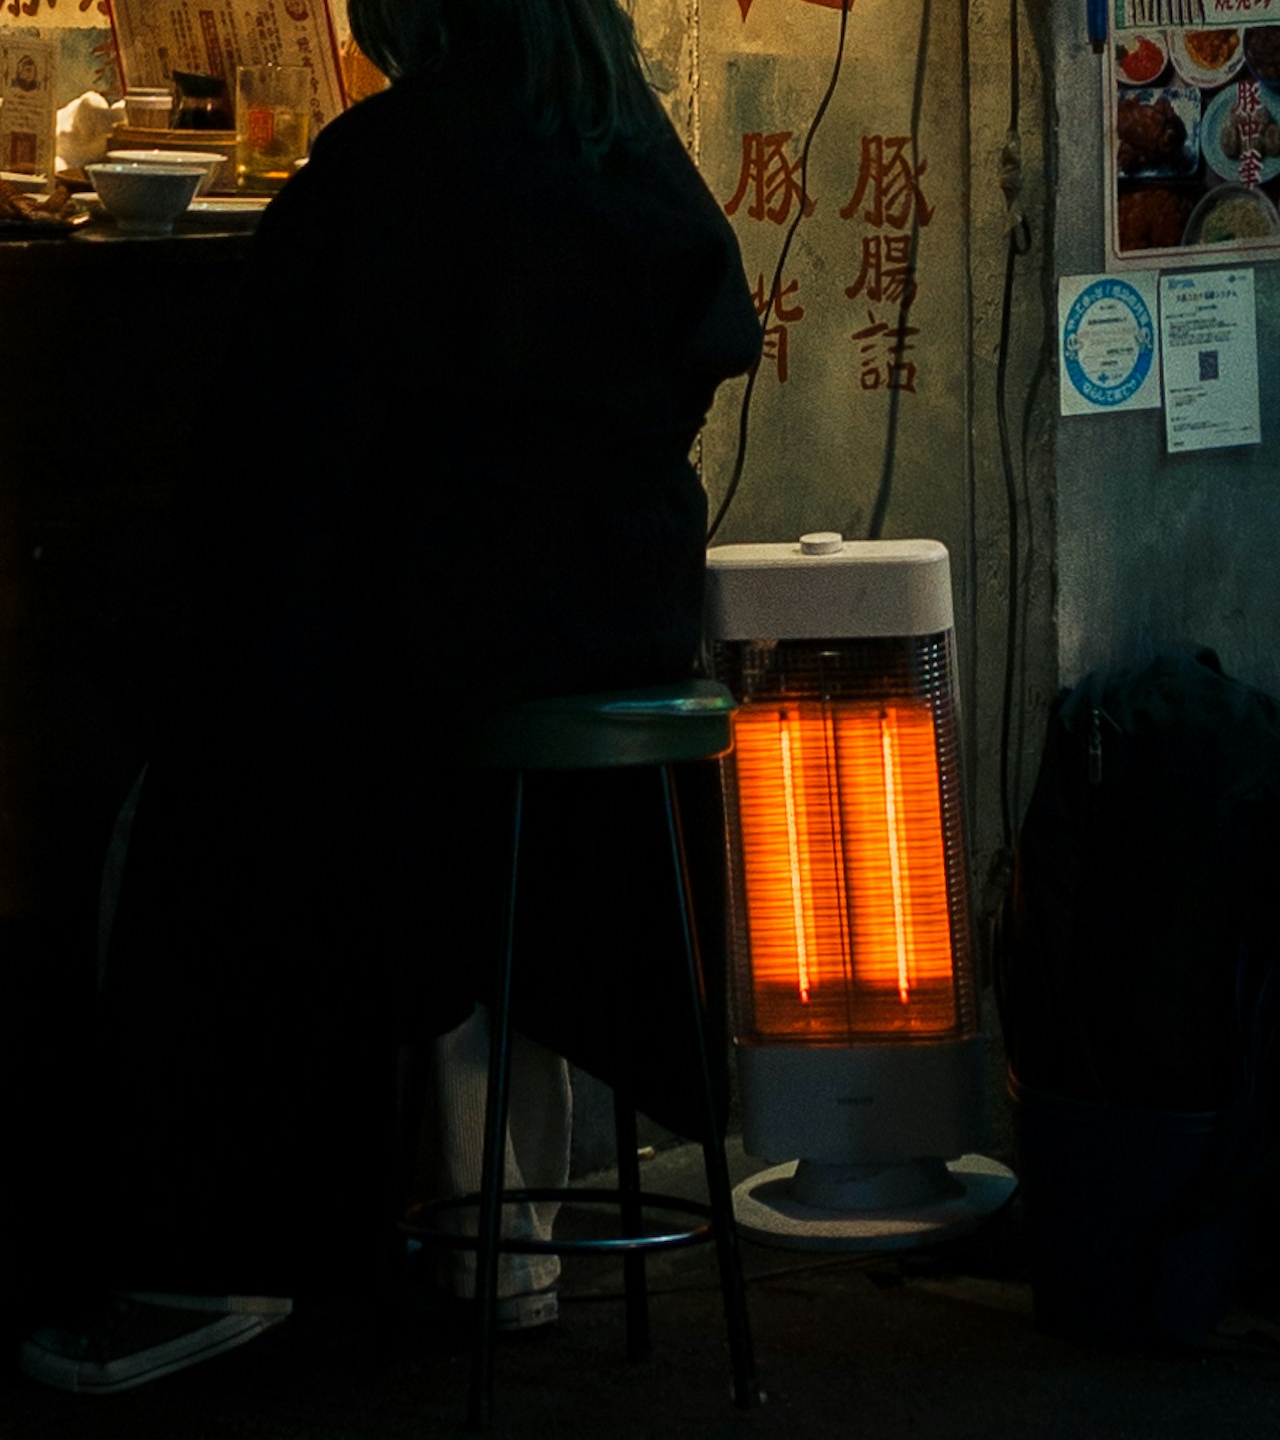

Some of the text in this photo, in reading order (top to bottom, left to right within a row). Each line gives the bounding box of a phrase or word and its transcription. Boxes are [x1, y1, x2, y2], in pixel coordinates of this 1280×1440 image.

[1237, 81, 1264, 189] 豚中華
[839, 134, 936, 394] 豚腸詰
